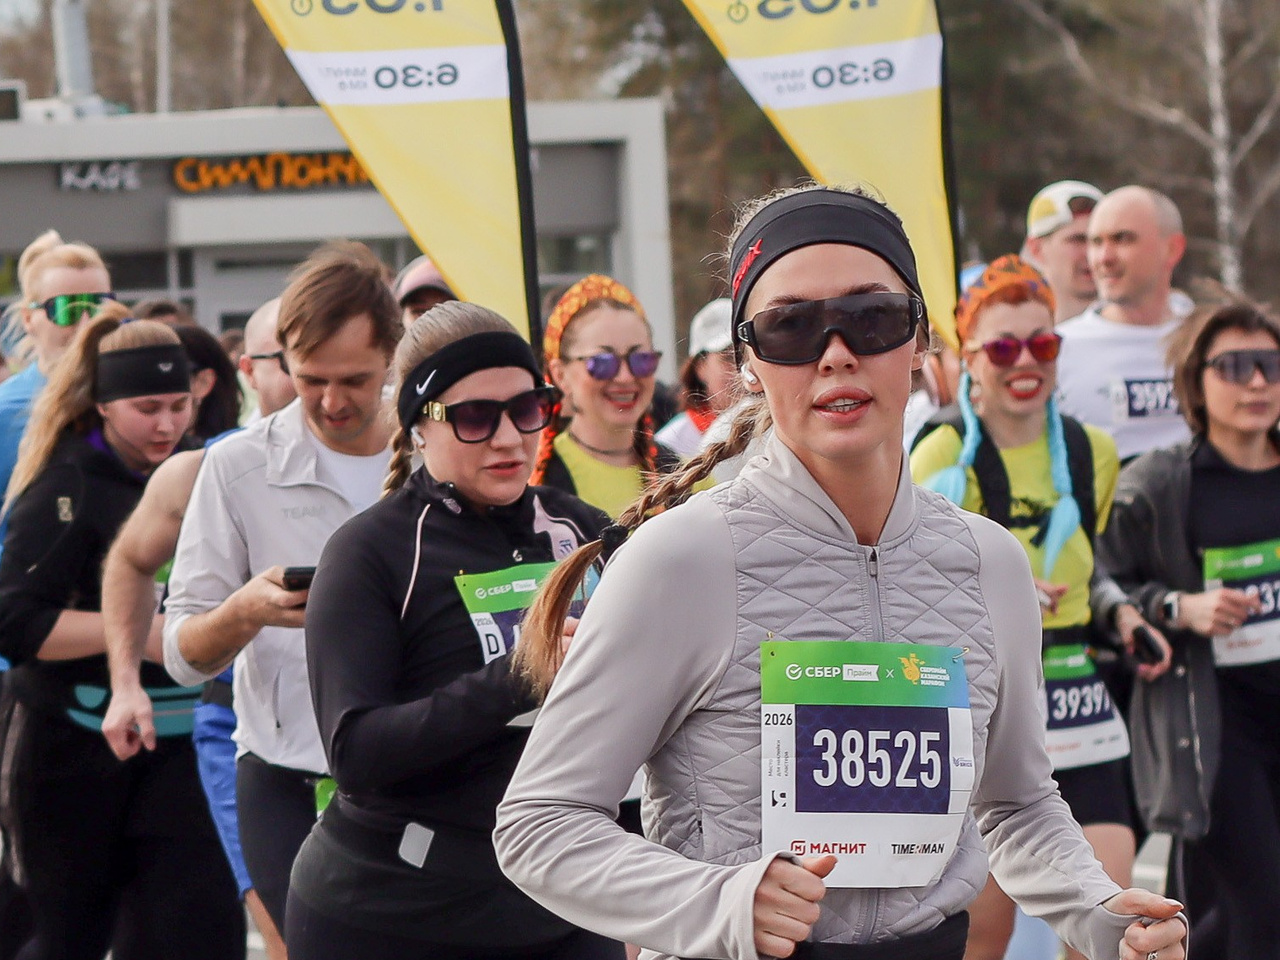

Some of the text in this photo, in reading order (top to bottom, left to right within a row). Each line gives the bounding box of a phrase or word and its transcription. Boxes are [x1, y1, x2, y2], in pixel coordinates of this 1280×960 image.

[485, 633, 499, 655] D
[805, 666, 841, 678] СБЕР
[764, 713, 793, 726] 2026
[813, 729, 941, 789] 38525
[810, 843, 867, 854] МАГНИТ
